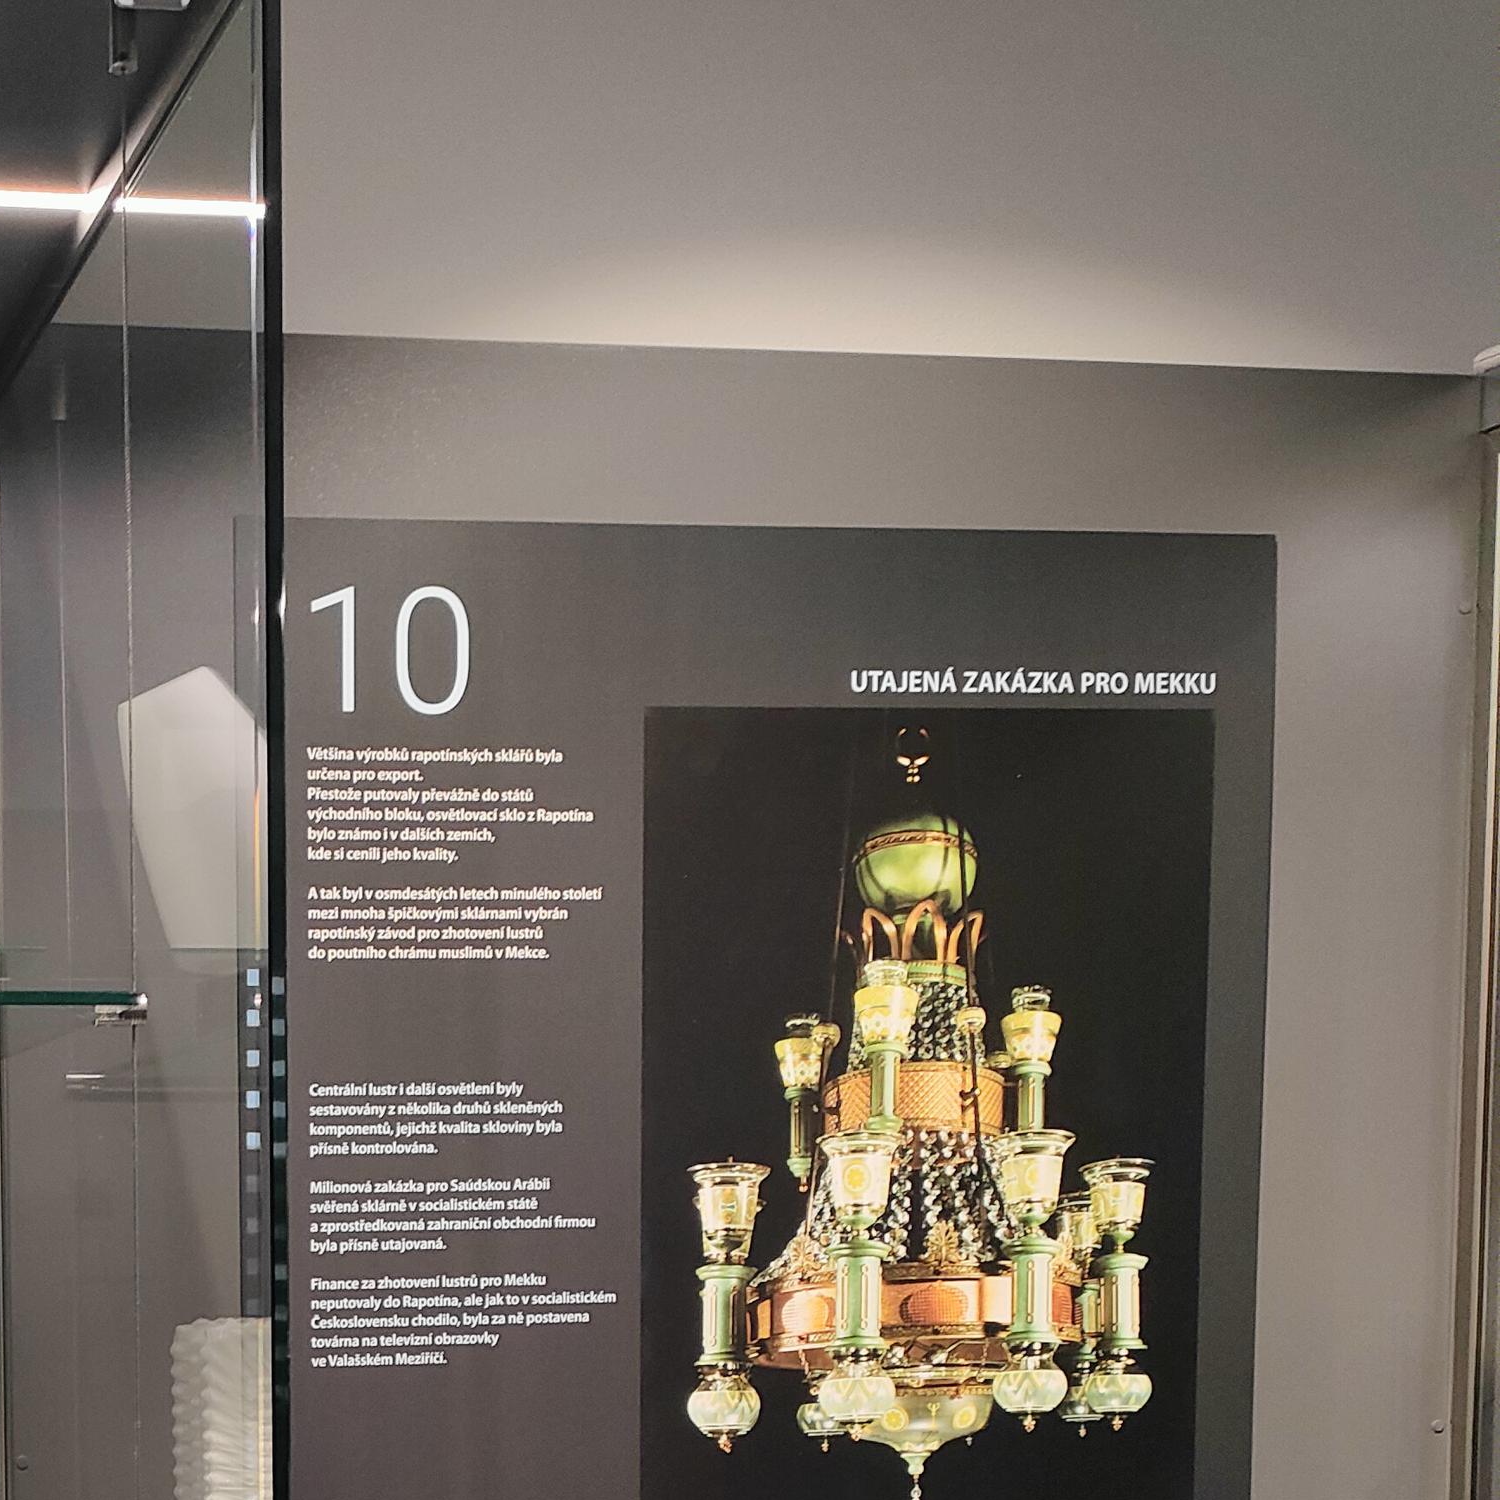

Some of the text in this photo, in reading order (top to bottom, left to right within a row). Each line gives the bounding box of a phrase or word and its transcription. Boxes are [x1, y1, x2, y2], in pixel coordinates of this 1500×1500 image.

[310, 586, 470, 715] 10
[850, 667, 1217, 695] UTAJENÁ ZAKÁZKA PRO MEKKU
[306, 747, 563, 766] Většina výrobků rapotínských sklářů byla
[306, 767, 424, 785] určena pro export.
[307, 787, 534, 804] Přestože putovaly převážně do států
[306, 807, 383, 824] východního
[384, 807, 424, 822] bloku,
[426, 807, 497, 820] osvětlovací
[498, 807, 526, 820] sklo
[536, 807, 594, 824] Rapotína
[307, 827, 336, 843] bylo
[337, 827, 381, 840] známo
[399, 827, 445, 840] dalších
[446, 827, 496, 841] zemích,
[307, 847, 458, 864] kde si cenili jeho kvality.
[307, 886, 318, 899] A
[319, 886, 341, 899] tak
[342, 886, 362, 902] byl
[374, 886, 458, 902] osmdesátých
[459, 886, 498, 899] letech
[500, 886, 561, 899] minulého
[562, 886, 602, 899] století
[307, 905, 568, 922] mezi mnoha špičkovými sklárnami vybrán
[307, 925, 543, 942] rapotínský závod pro zhotovení lustrů
[307, 945, 326, 959] do
[327, 945, 387, 962] poutního
[388, 945, 436, 958] chrámu
[438, 945, 493, 958] muslimů
[504, 945, 550, 958] Mekce.
[308, 1082, 366, 1096] Centrální
[368, 1082, 398, 1095] lustr
[405, 1082, 435, 1095] další
[437, 1081, 494, 1095] osvětlení
[496, 1081, 523, 1098] byly
[309, 1101, 386, 1119] sestavovány
[397, 1101, 451, 1114] několika
[452, 1100, 491, 1114] druhů
[492, 1100, 562, 1117] skleněných
[309, 1119, 562, 1138] komponentů, jejichž kvalita skloviny byla
[309, 1140, 438, 1158] přísně kontrolována.
[309, 1176, 550, 1195] Milionová zakázka pro Saúdskou Arábii
[309, 1198, 359, 1212] svěřená
[360, 1198, 407, 1211] sklárně
[418, 1197, 504, 1211] socialistickém
[506, 1196, 538, 1210] státě
[320, 1217, 425, 1235] zprostředkovaná
[426, 1216, 491, 1230] zahraniční
[492, 1215, 552, 1229] obchodní
[554, 1215, 595, 1228] firmou
[310, 1236, 447, 1255] byla přísně utajovaná.
[310, 1273, 546, 1290] Finance za zhotovení lustrů pro Mekku
[310, 1294, 382, 1312] neputovaly
[383, 1294, 401, 1307] do
[402, 1293, 462, 1311] Rapotína,
[463, 1292, 483, 1306] ale
[485, 1292, 504, 1309] jak
[505, 1292, 520, 1305] to
[531, 1290, 616, 1304] socialistickém
[310, 1310, 589, 1329] Československu chodilo, byla za ně postavena
[310, 1331, 499, 1349] továrna na televizní obrazovky
[311, 1352, 447, 1367] ve Valašském Meziříčí.
